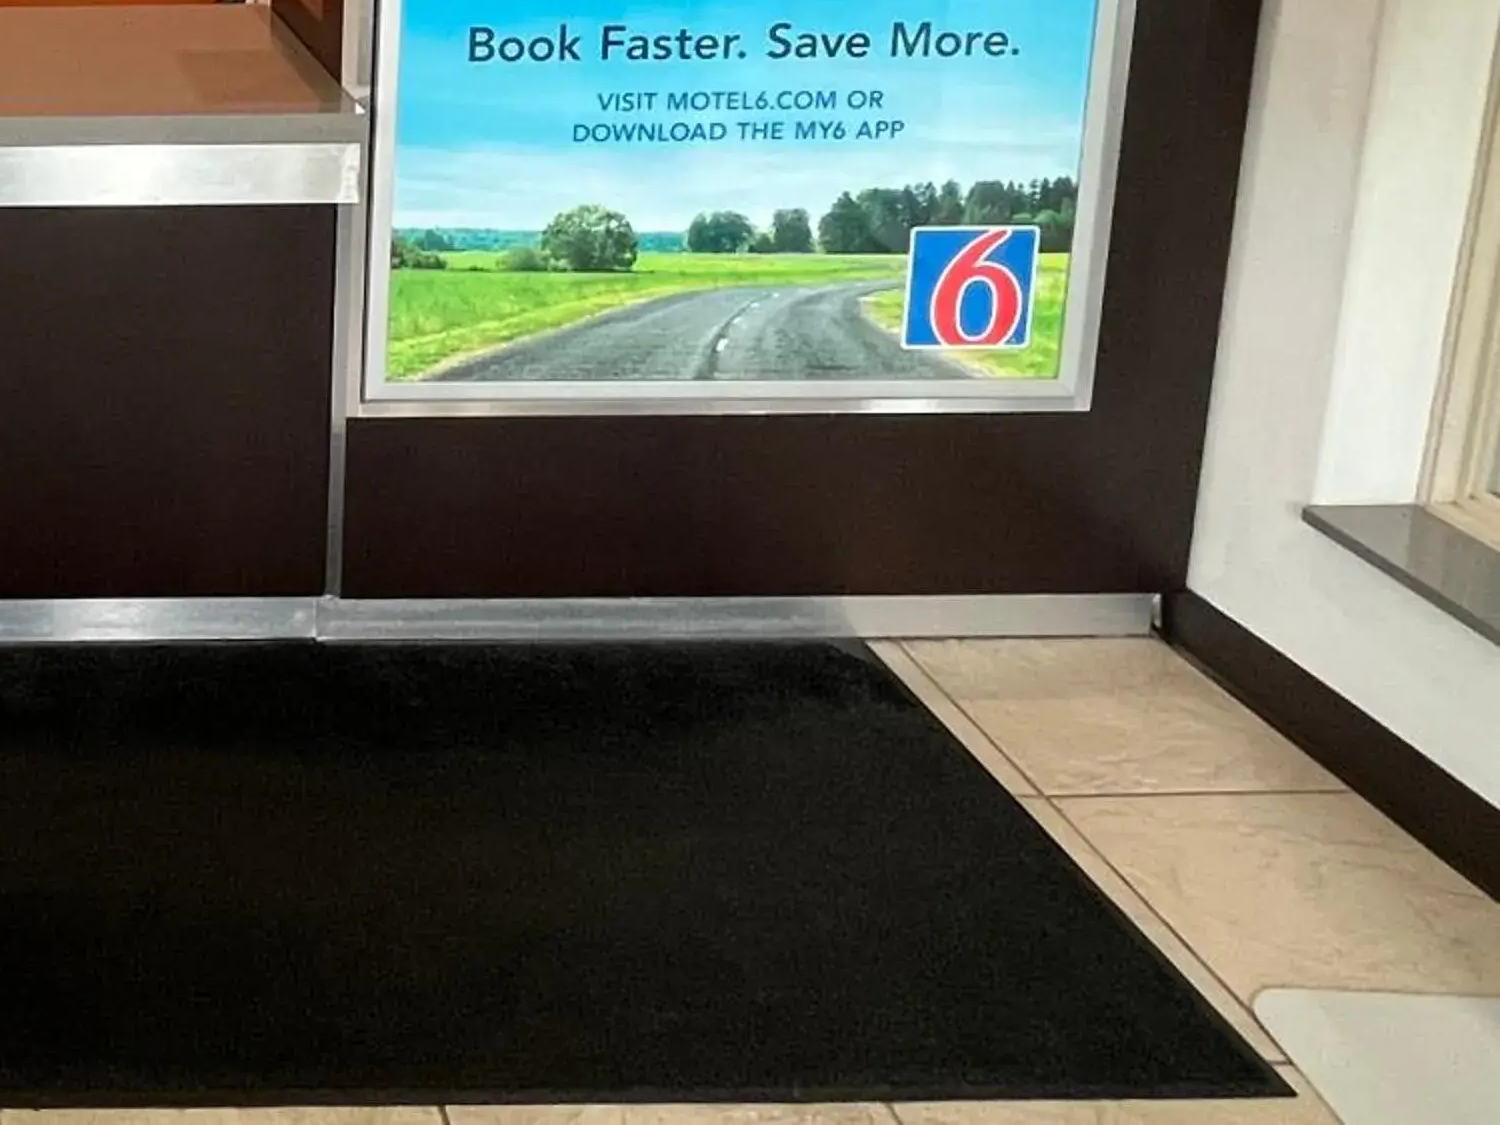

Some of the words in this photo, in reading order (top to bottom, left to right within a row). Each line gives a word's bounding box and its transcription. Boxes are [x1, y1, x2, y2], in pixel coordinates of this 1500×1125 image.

[467, 24, 582, 62] Book
[601, 24, 746, 61] Faster.
[766, 23, 870, 59] Save
[890, 22, 1020, 57] More.
[597, 92, 657, 112] VISIT
[667, 91, 837, 111] MOTEL6.COM
[847, 89, 884, 110] OR
[573, 122, 727, 143] DOWNLOAD
[737, 122, 783, 141] THE
[795, 121, 846, 141] MY6
[856, 119, 905, 140] APP
[930, 226, 1023, 349] 6
